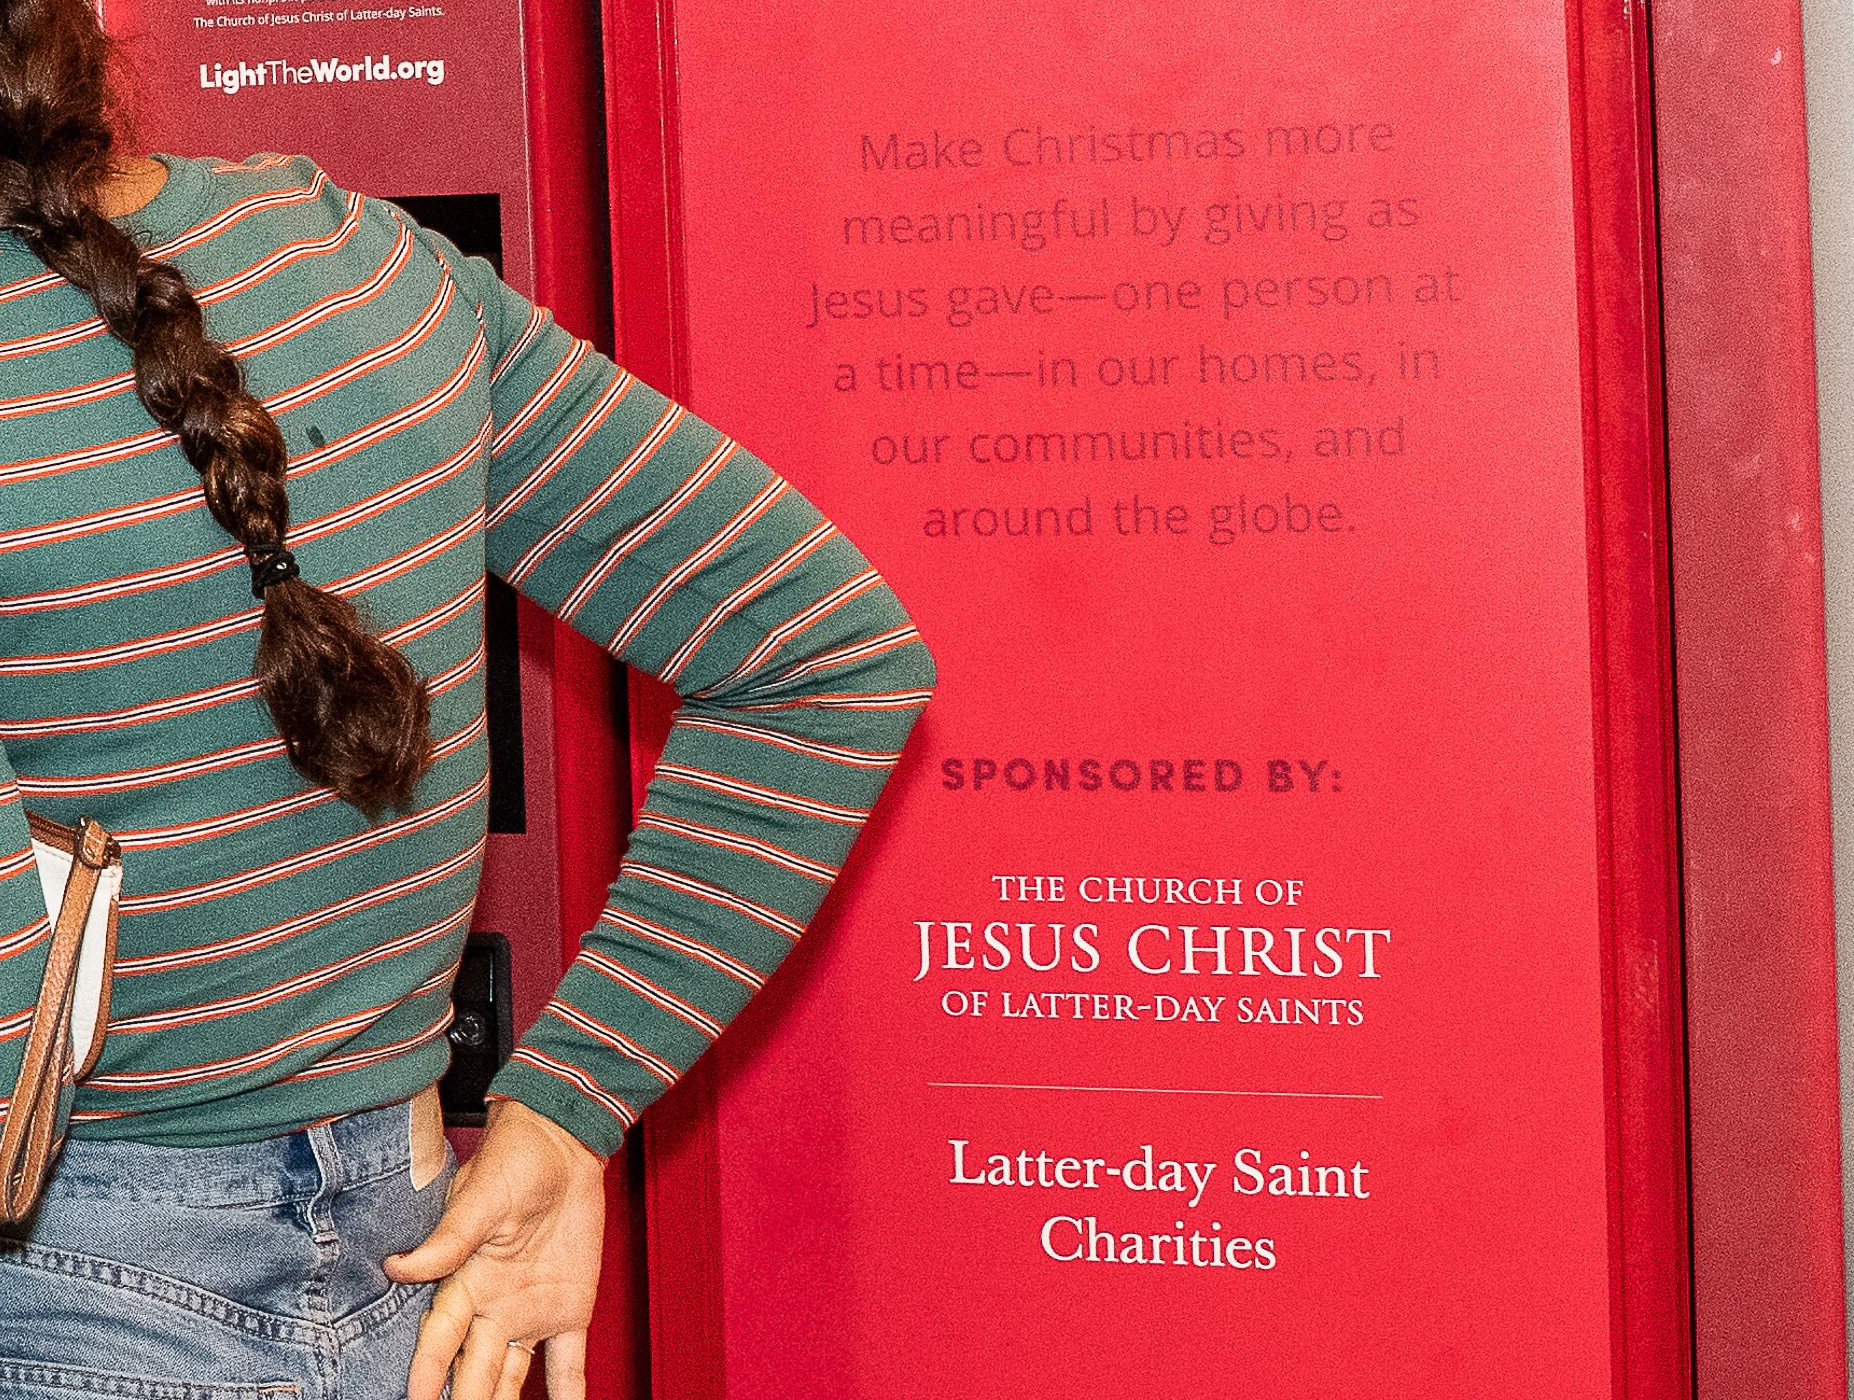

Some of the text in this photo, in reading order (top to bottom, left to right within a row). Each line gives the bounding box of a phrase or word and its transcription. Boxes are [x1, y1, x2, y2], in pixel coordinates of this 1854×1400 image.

[199, 55, 445, 95] LightTheWorld.org
[860, 118, 1394, 174] Make Christmas more
[842, 193, 1421, 252] meaningful by giving as
[807, 281, 927, 329] Jesus
[1222, 267, 1394, 319] person
[1414, 267, 1462, 303] at
[833, 364, 858, 393] a
[1096, 354, 1179, 387] our
[1198, 342, 1376, 389] homes,
[1397, 342, 1440, 381] in
[870, 417, 1406, 466] our communities, and
[922, 491, 1357, 547] around the globe.
[941, 757, 1344, 794] SPONSORED BY:
[992, 873, 1306, 907] THE CHURCH OF
[912, 920, 1392, 982] JESUS CHRIST
[941, 991, 1365, 1028] OF LATTER-DAY SAINTS
[947, 1138, 1371, 1208] Latter-day Saint
[1040, 1215, 1277, 1271] Charities
